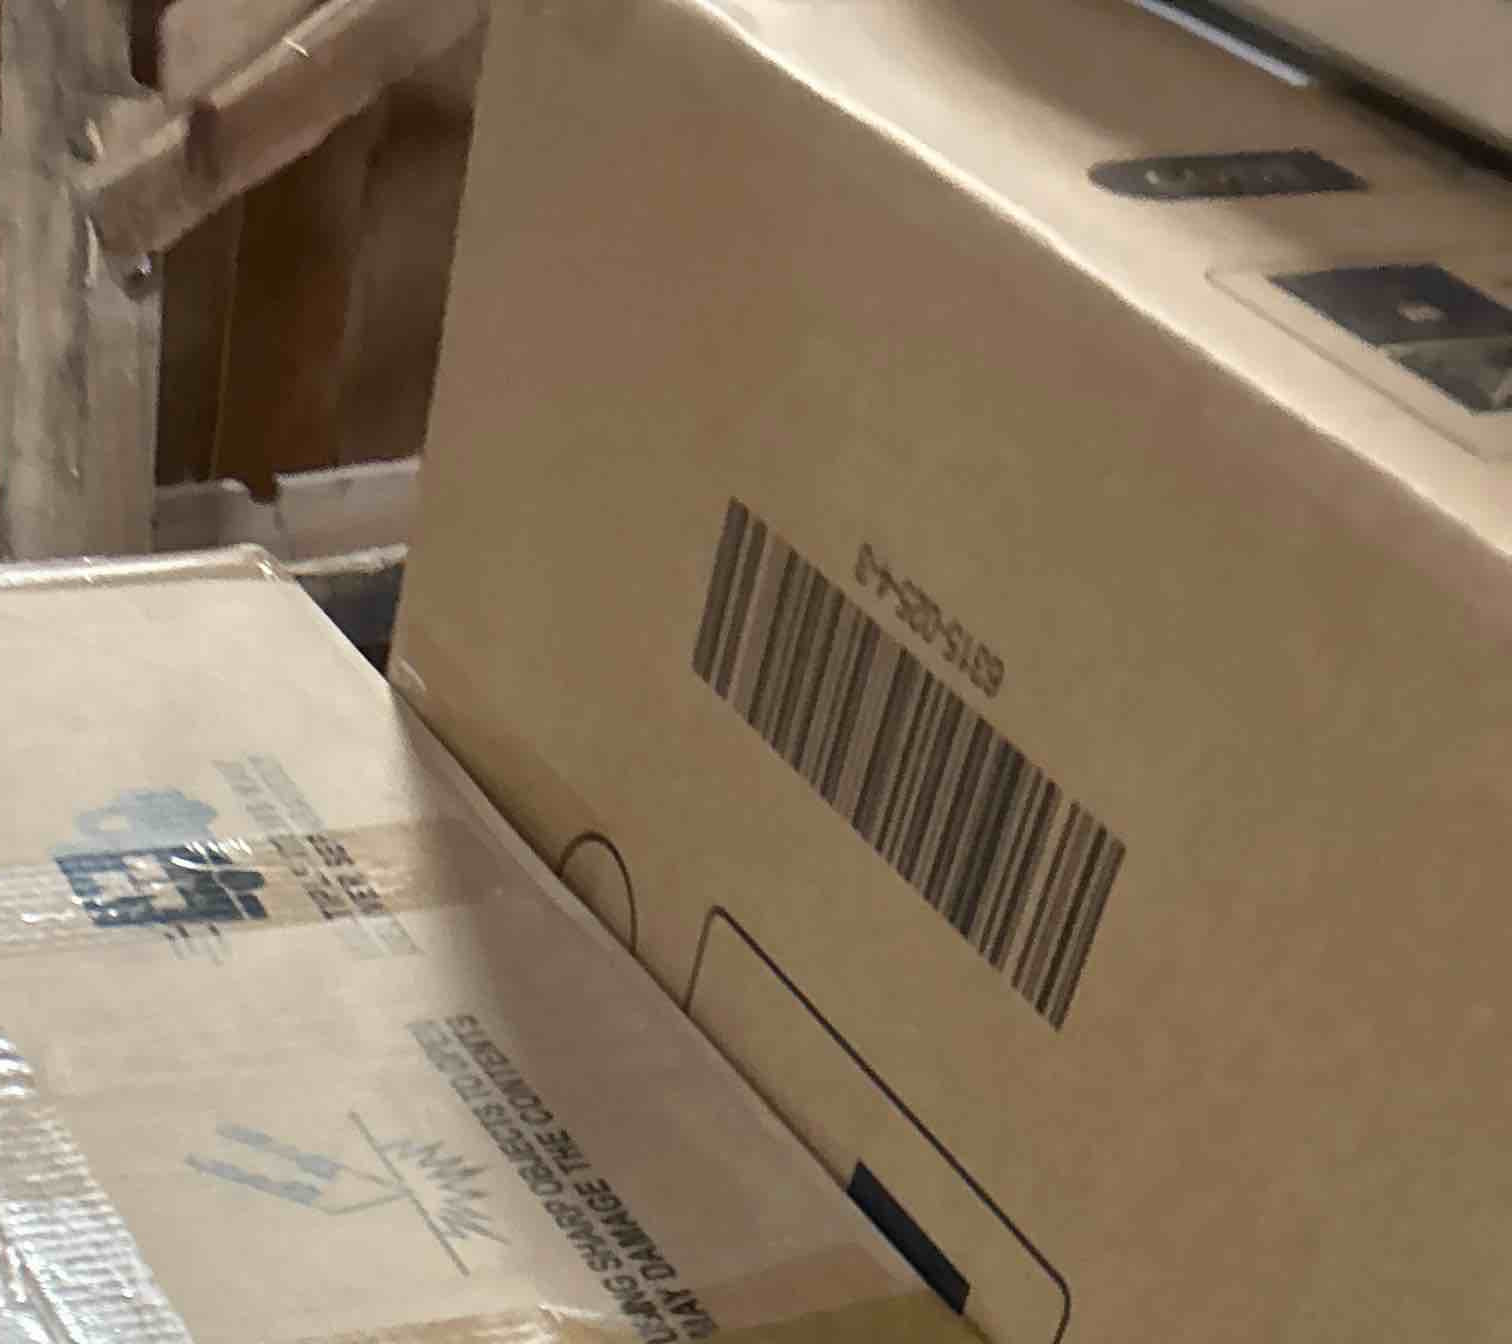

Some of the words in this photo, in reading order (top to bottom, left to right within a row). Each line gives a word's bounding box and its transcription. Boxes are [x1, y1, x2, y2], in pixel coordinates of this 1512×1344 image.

[445, 1013, 553, 1126] CONTENTS
[472, 1102, 563, 1197] OBJECTS
[534, 1127, 590, 1176] THE
[542, 1198, 622, 1273] SHARP
[574, 1177, 676, 1281] DAMAGE
[600, 1275, 678, 1344] USING
[656, 1288, 719, 1341] MAY
